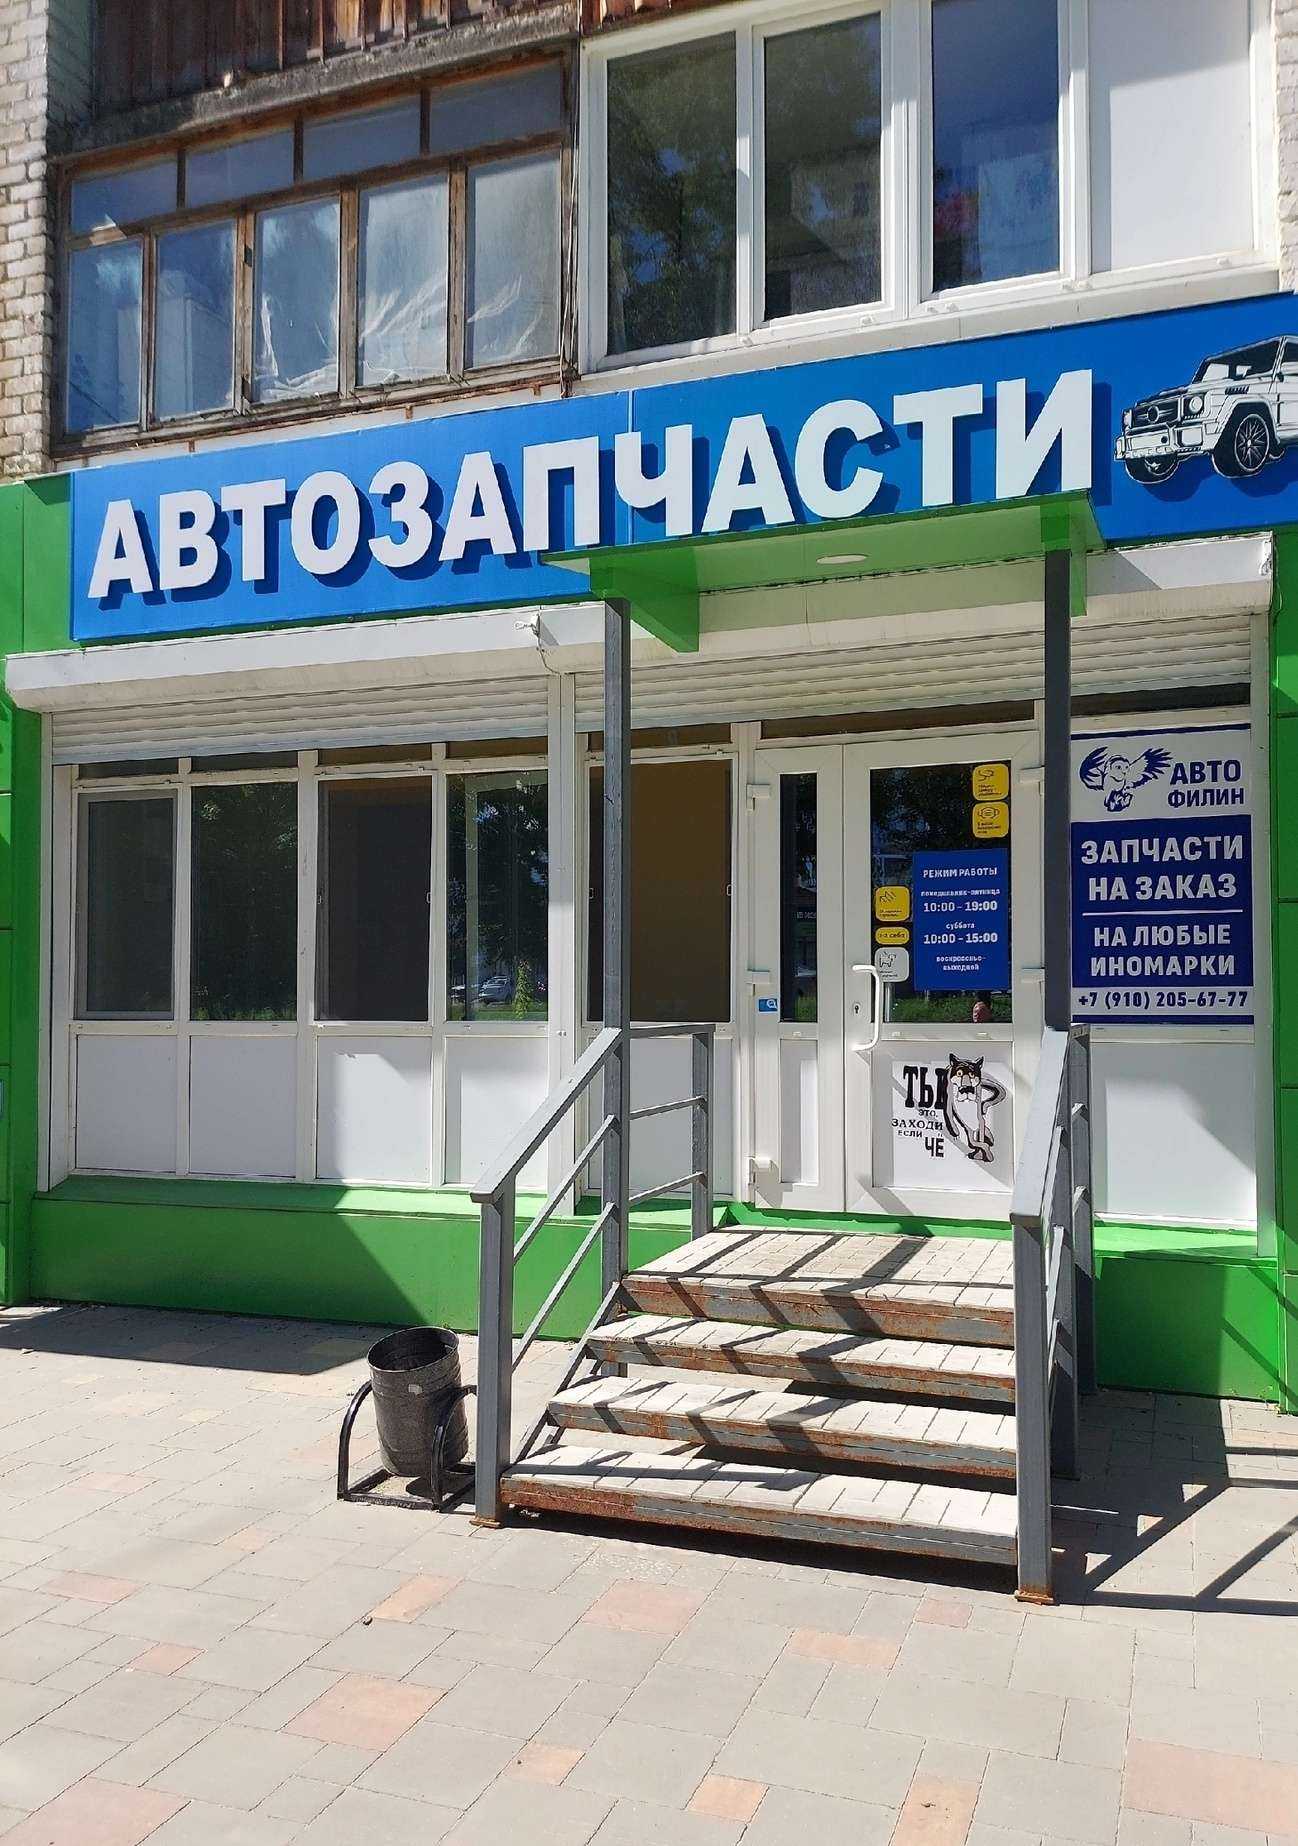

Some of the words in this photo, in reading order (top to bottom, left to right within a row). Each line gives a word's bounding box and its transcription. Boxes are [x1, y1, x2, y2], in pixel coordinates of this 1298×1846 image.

[88, 369, 1092, 598] АВТОЗАПЧАСТИ
[1170, 759, 1241, 785] АВТО
[1168, 787, 1244, 808] ФИЛИН
[1081, 835, 1243, 864] ЗАПЧАСТИ
[923, 868, 957, 878] РЕЖИМ
[959, 867, 997, 877] РАБОТЫ
[1088, 877, 1129, 901] НА
[1136, 874, 1237, 900] ЗАКАЗ
[923, 902, 955, 912] 10:00
[965, 901, 998, 911] 19:00
[945, 921, 975, 930] суббота
[1094, 928, 1127, 947] НА
[1133, 924, 1231, 946] ЛЮБЫЕ
[923, 934, 956, 944] 10:00
[965, 932, 998, 943] 15:00
[1090, 955, 1235, 977] ИНОМАРКИ
[1078, 991, 1098, 1007] +7
[1105, 991, 1150, 1010] (910)
[1156, 991, 1248, 1007] 205-67-77
[891, 1118, 943, 1131] ЗАХОДИ
[898, 1129, 923, 1138] ЕСЛИ
